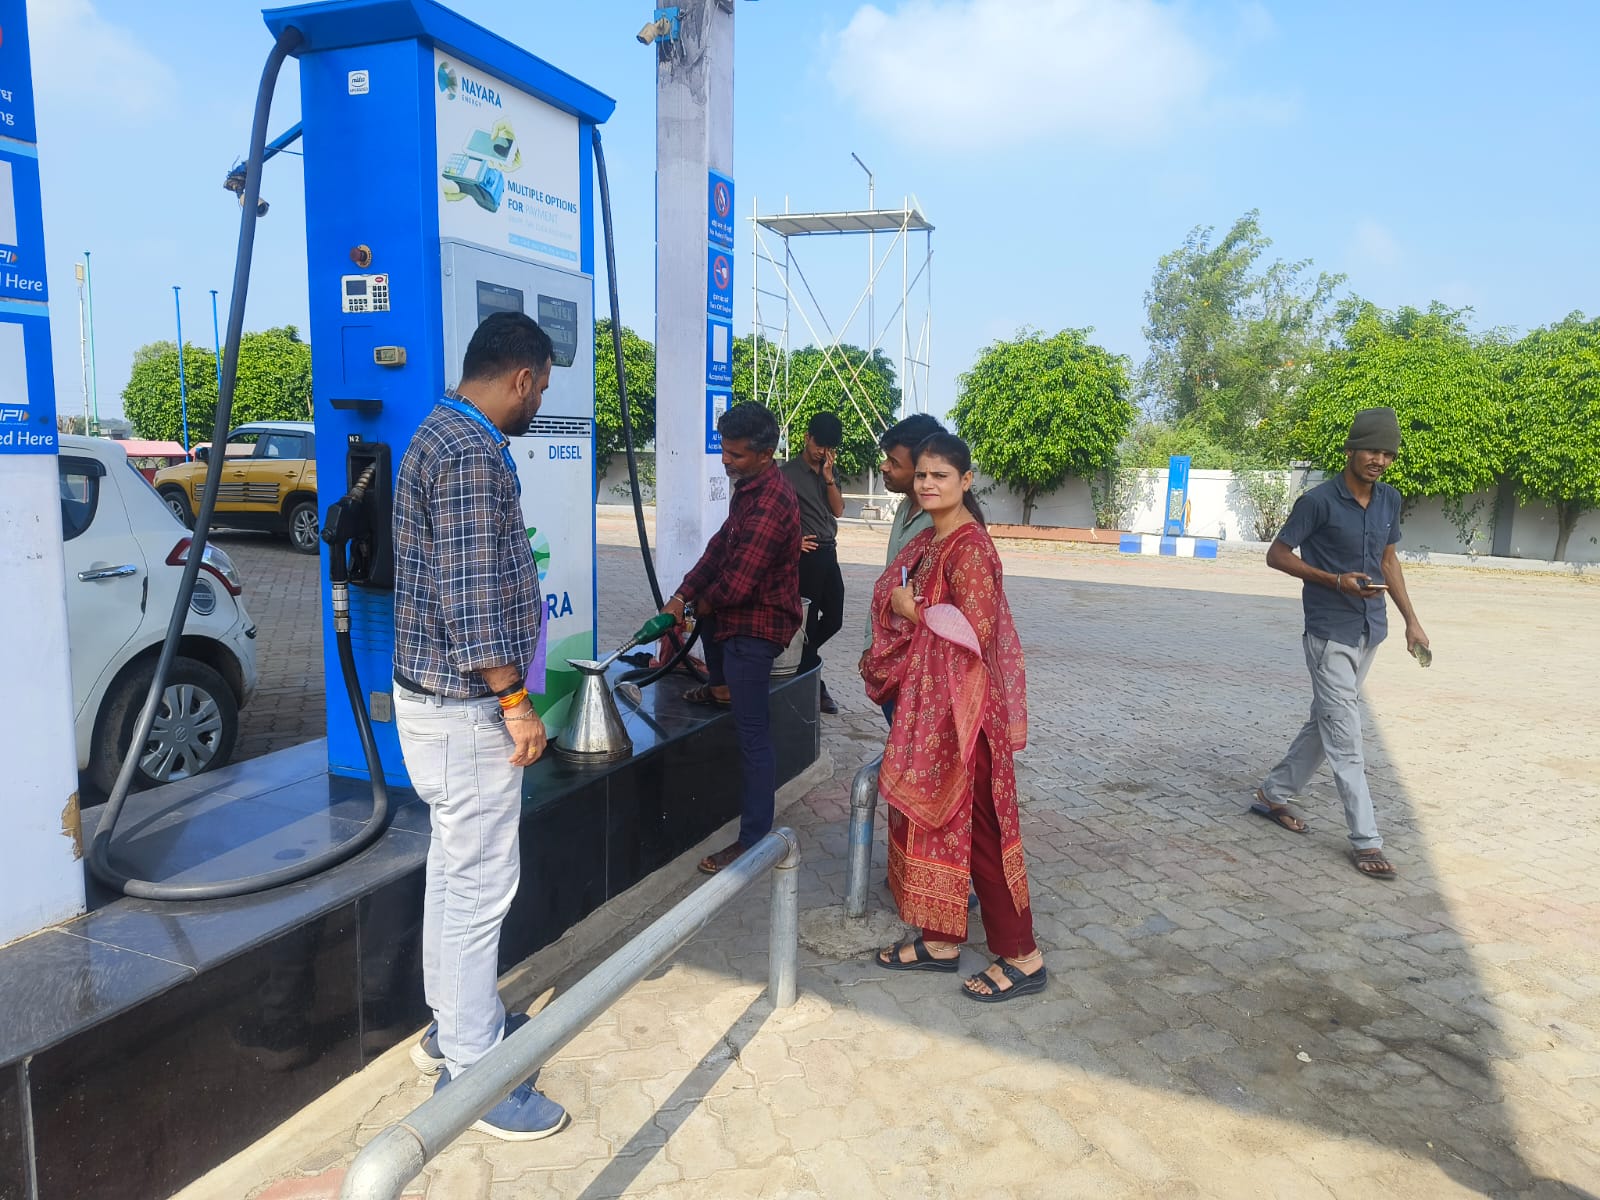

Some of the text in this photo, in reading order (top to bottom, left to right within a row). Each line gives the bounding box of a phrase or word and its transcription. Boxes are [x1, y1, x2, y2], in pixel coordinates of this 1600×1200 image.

[461, 76, 502, 109] NAYARA
[507, 179, 577, 214] MULTIPLE OPTIONS
[507, 198, 524, 213] FOR
[5, 272, 43, 292] Here
[17, 431, 54, 446] Here
[548, 445, 582, 460] DIESEL
[546, 591, 574, 620] RA
